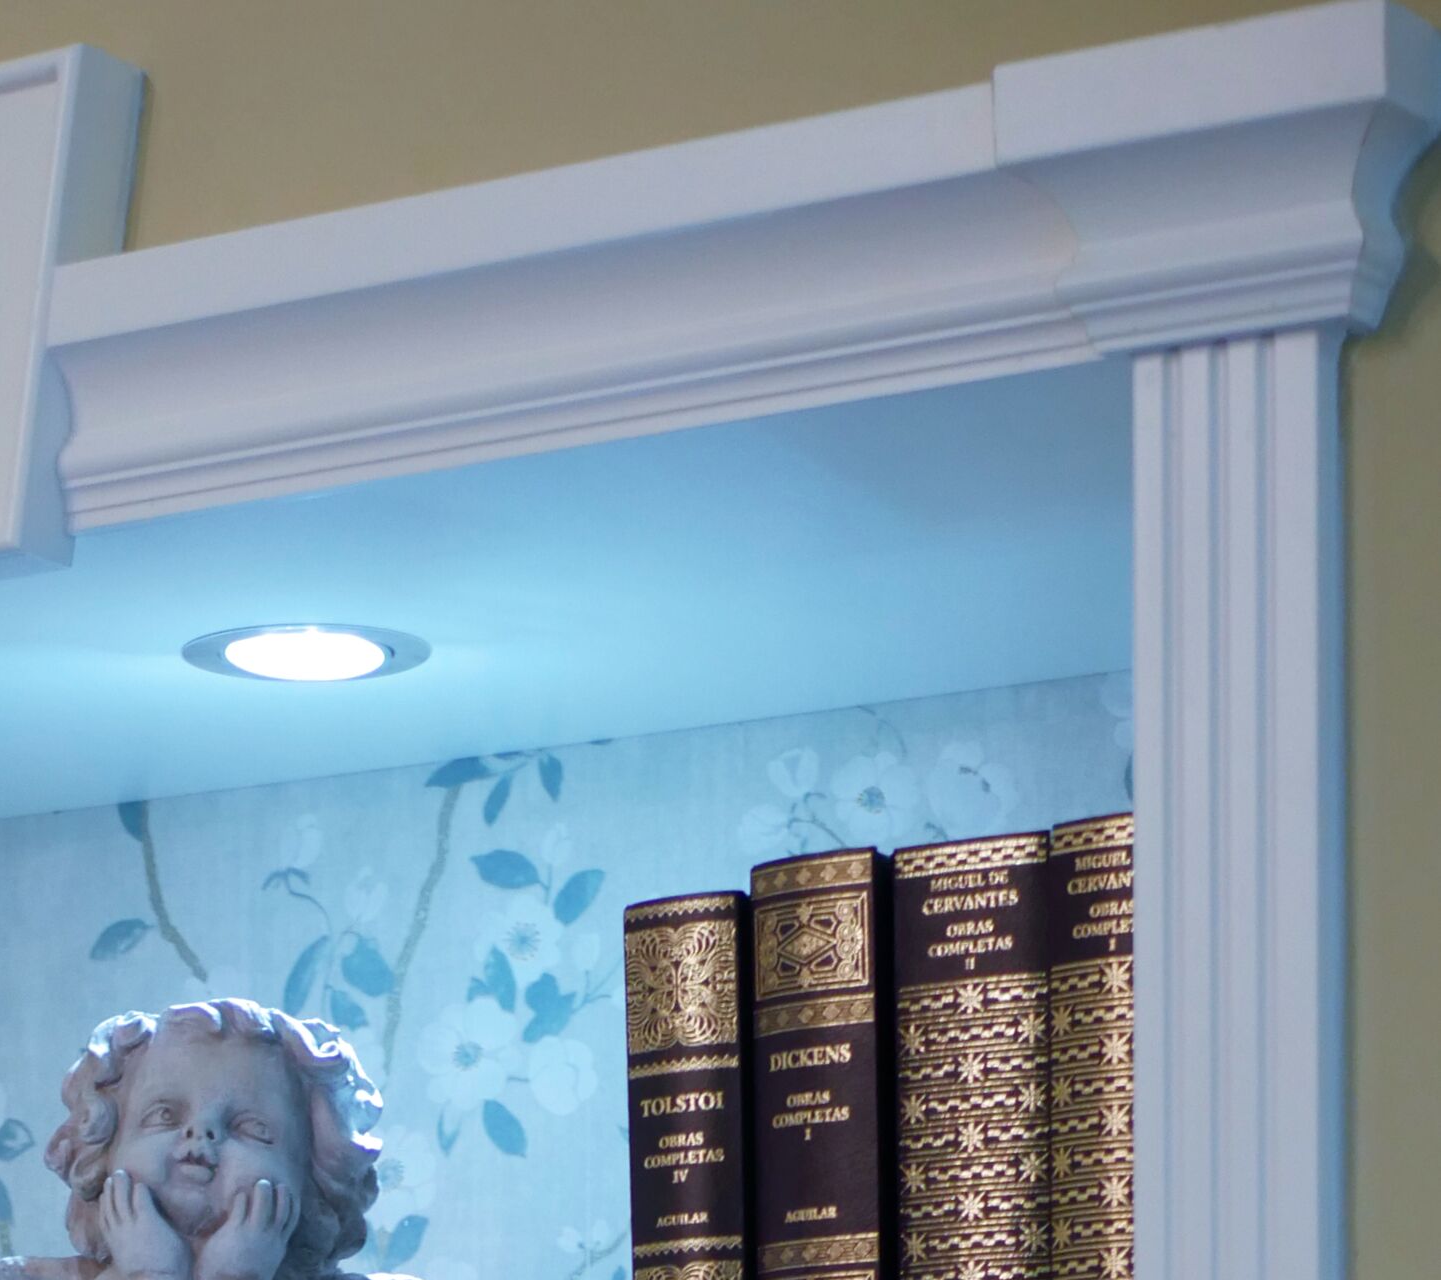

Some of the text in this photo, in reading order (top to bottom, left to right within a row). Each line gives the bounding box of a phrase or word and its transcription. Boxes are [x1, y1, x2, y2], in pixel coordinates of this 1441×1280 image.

[1074, 850, 1131, 871] MIGUEL
[930, 870, 1009, 892] MIGUEL DE
[922, 888, 1019, 916] CERVANTES
[946, 918, 995, 938] OBRAS
[927, 936, 1013, 959] COMPLETAS
[964, 957, 975, 970] II
[769, 1043, 852, 1073] DICKENS
[640, 1091, 724, 1118] TOLSTOI
[786, 1090, 831, 1108] OBRAS
[772, 1106, 850, 1129] COMPLETAS
[658, 1131, 705, 1149] OBRAS
[804, 1128, 812, 1142] I
[643, 1148, 725, 1169] COMPLETAS
[672, 1168, 689, 1184] IV
[656, 1211, 709, 1228] AGUILAR
[785, 1206, 838, 1223] AGUILAR
